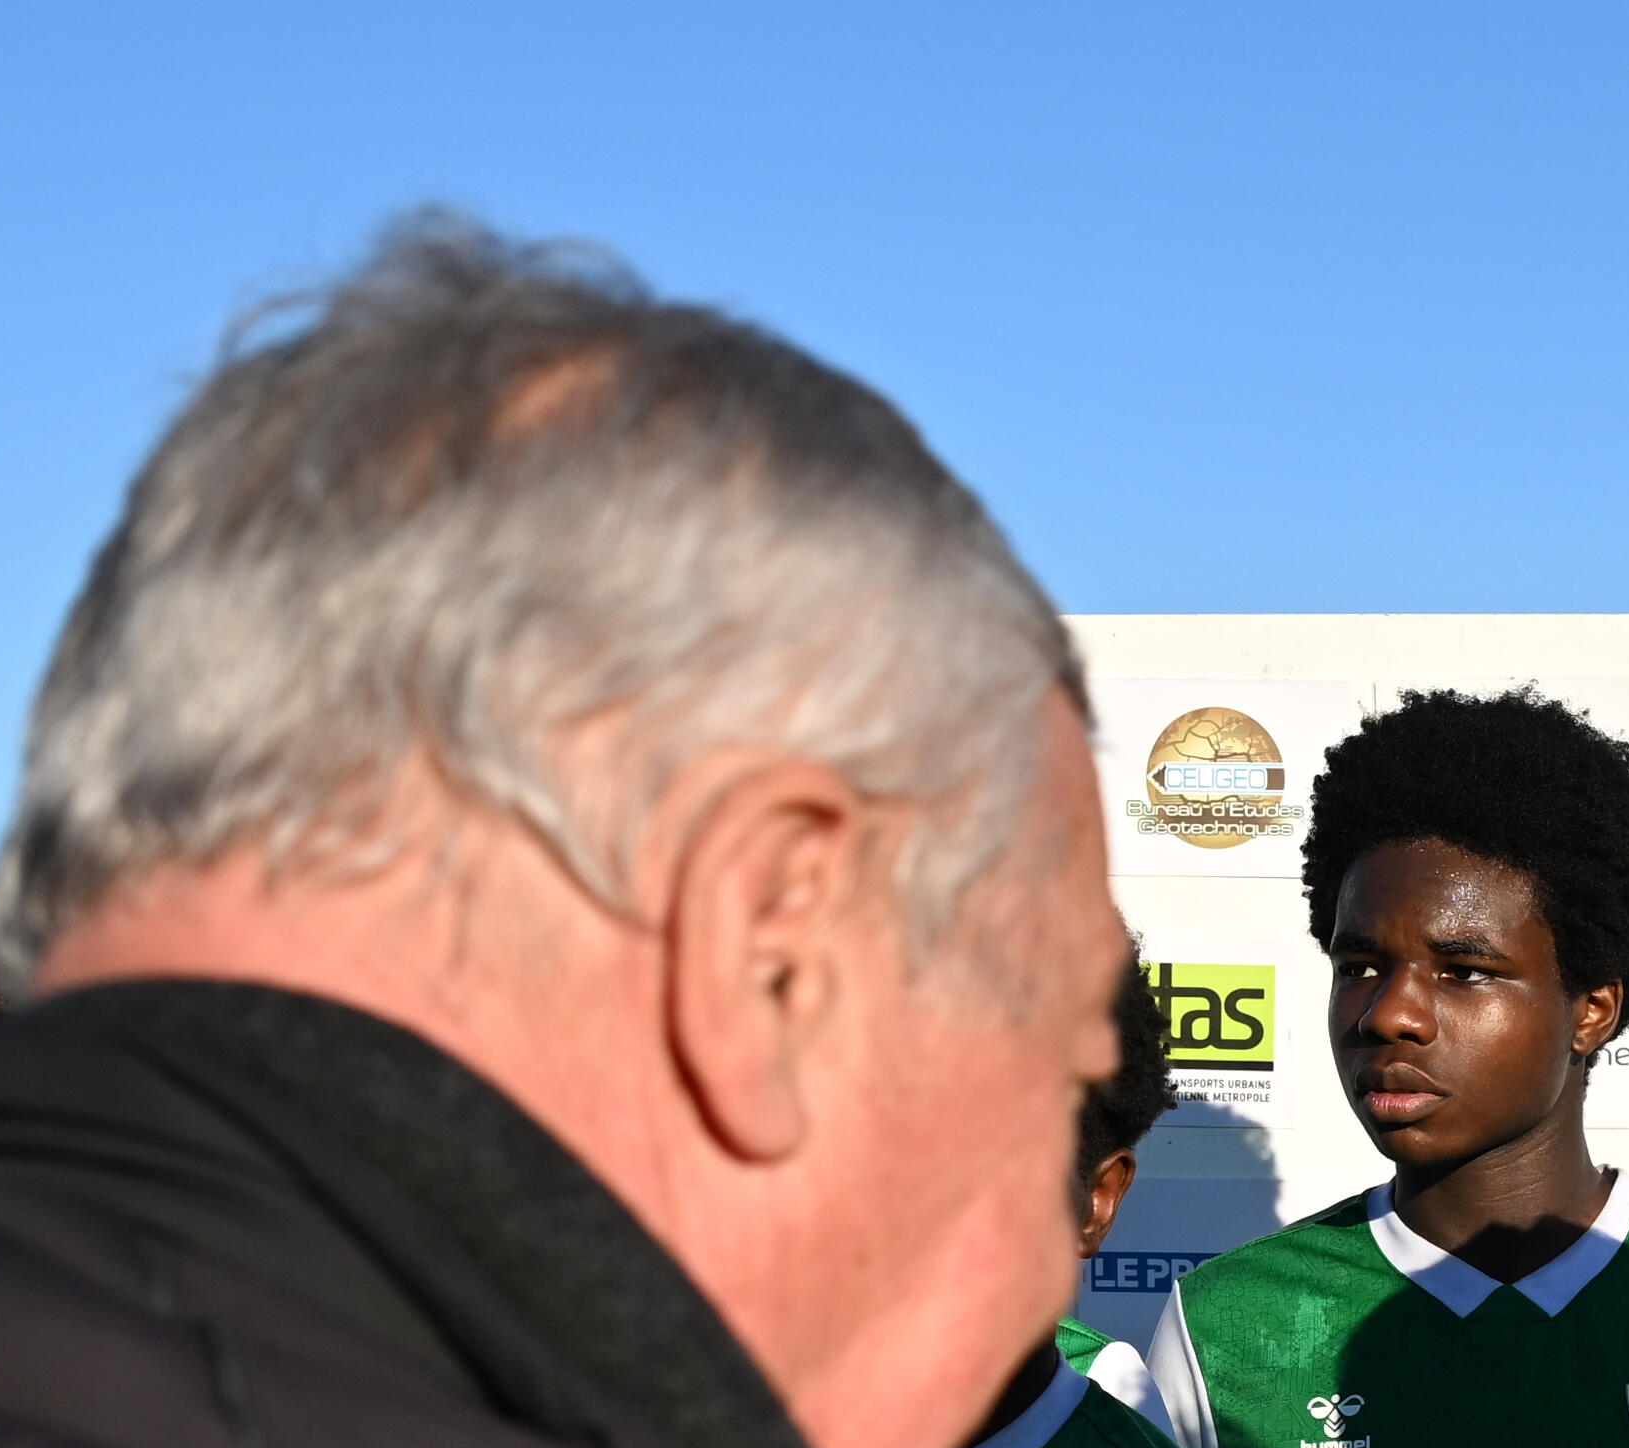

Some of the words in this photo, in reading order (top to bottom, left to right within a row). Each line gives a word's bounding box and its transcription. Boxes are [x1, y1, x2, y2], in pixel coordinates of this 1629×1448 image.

[1166, 767, 1267, 789] CELIGEO
[1126, 800, 1204, 818] Bureau
[1211, 801, 1304, 818] d'Etudes
[1138, 818, 1294, 839] Géotechniques
[1228, 1080, 1271, 1090] URBAINS
[1213, 1092, 1271, 1103] METROPOLE
[1095, 1257, 1139, 1288] LE
